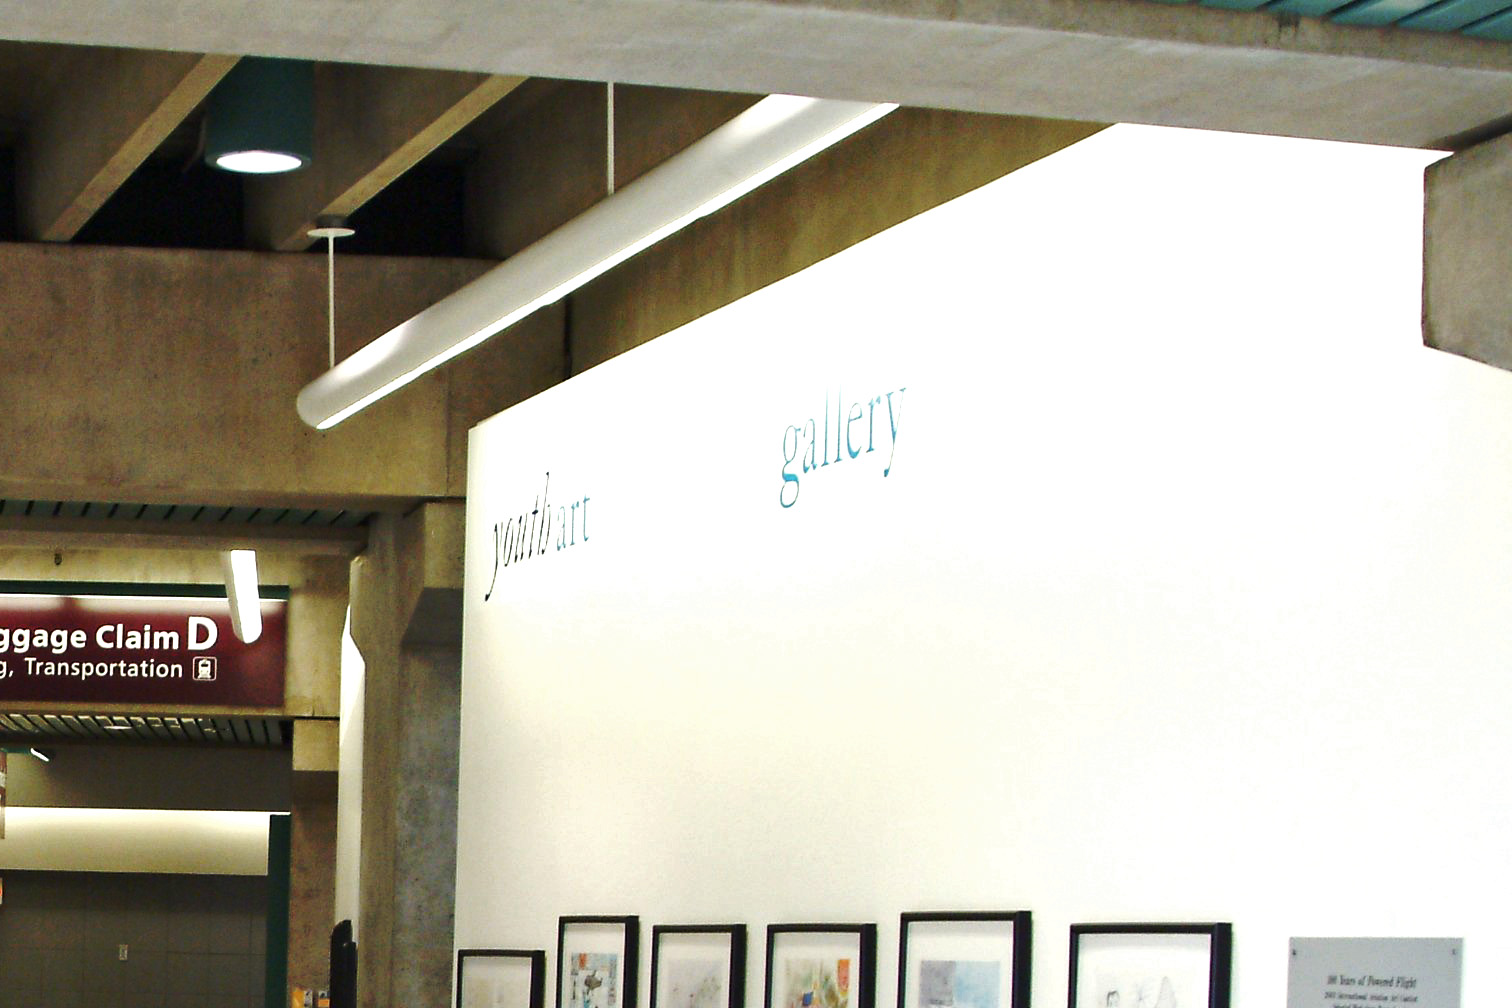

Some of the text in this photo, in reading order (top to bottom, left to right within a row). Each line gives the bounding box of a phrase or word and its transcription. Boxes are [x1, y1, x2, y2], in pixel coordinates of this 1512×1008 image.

[780, 383, 906, 508] gallery
[557, 495, 590, 551] art
[95, 624, 180, 650] Claim
[188, 616, 218, 650] D
[24, 657, 183, 680] Transportation
